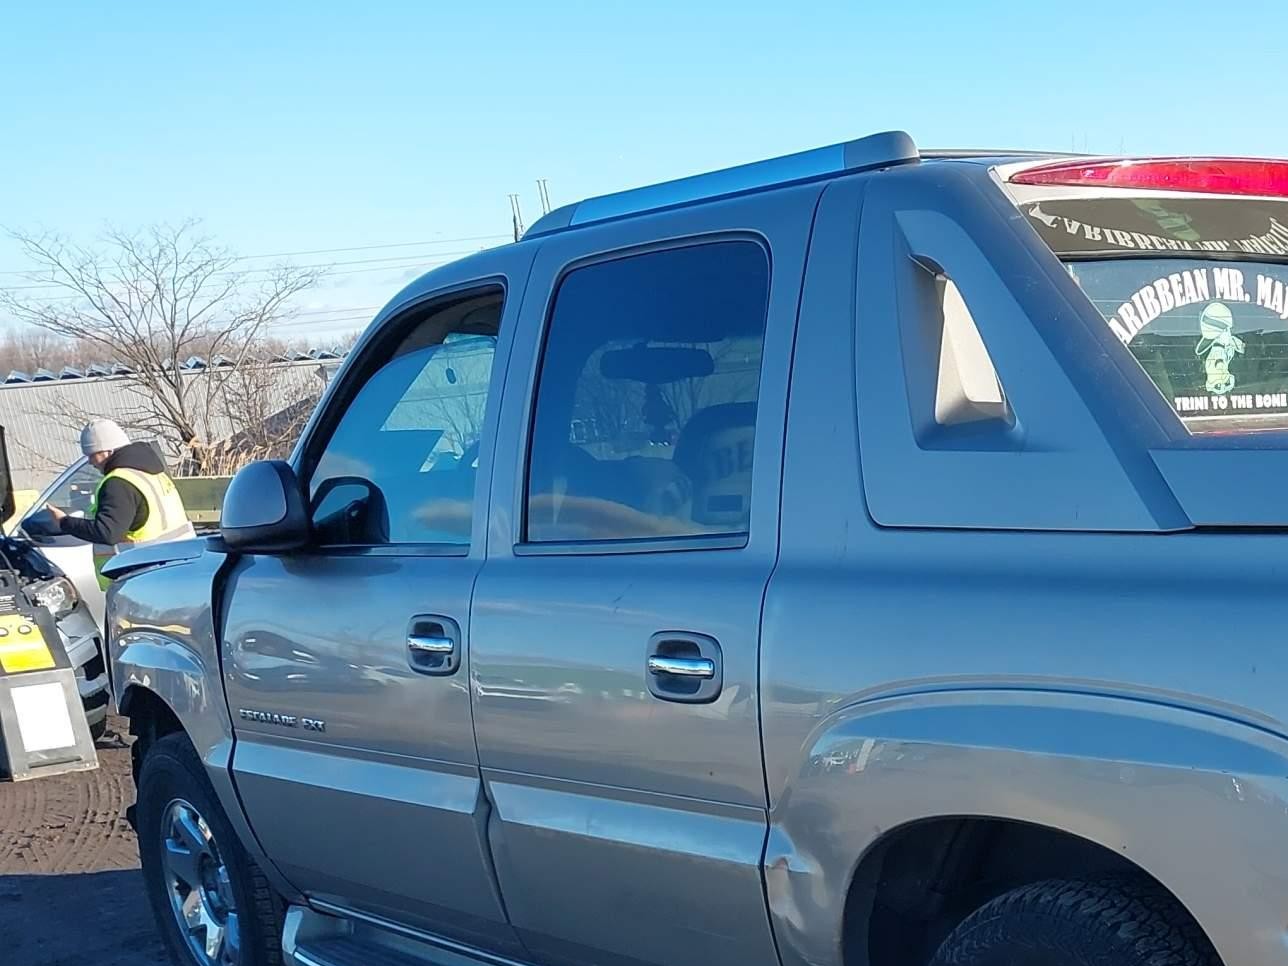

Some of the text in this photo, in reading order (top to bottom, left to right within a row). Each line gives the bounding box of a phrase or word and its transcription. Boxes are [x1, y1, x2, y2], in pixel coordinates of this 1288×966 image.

[1108, 267, 1209, 345] ARIBBEAN
[1213, 267, 1250, 302] MR.
[1174, 396, 1209, 411] TRINI
[1211, 395, 1228, 410] TO
[1230, 394, 1253, 409] THE
